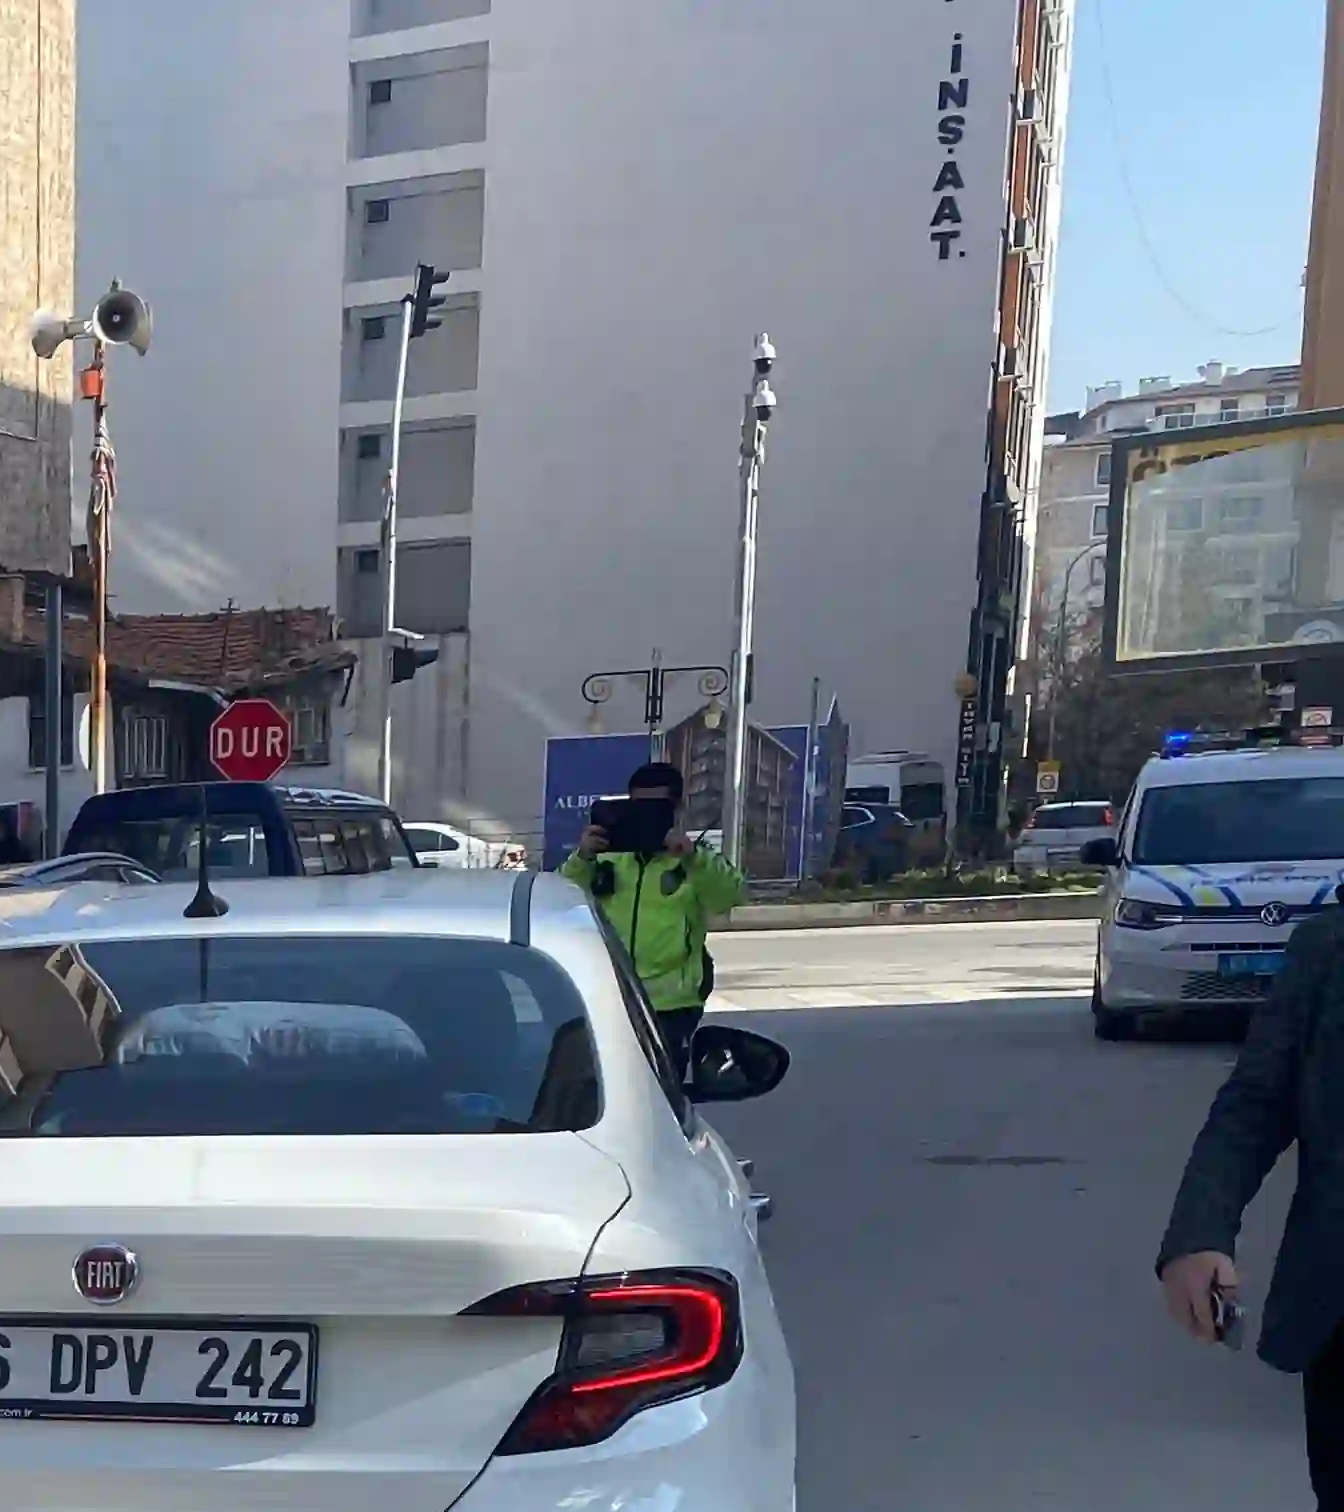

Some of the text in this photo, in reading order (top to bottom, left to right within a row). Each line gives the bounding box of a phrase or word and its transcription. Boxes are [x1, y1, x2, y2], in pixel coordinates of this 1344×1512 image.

[216, 726, 283, 759] DUR
[87, 1261, 124, 1289] FIAT
[50, 1334, 154, 1396] DPV
[196, 1337, 302, 1399] 242
[234, 1411, 259, 1424] 444
[262, 1412, 280, 1424] 77
